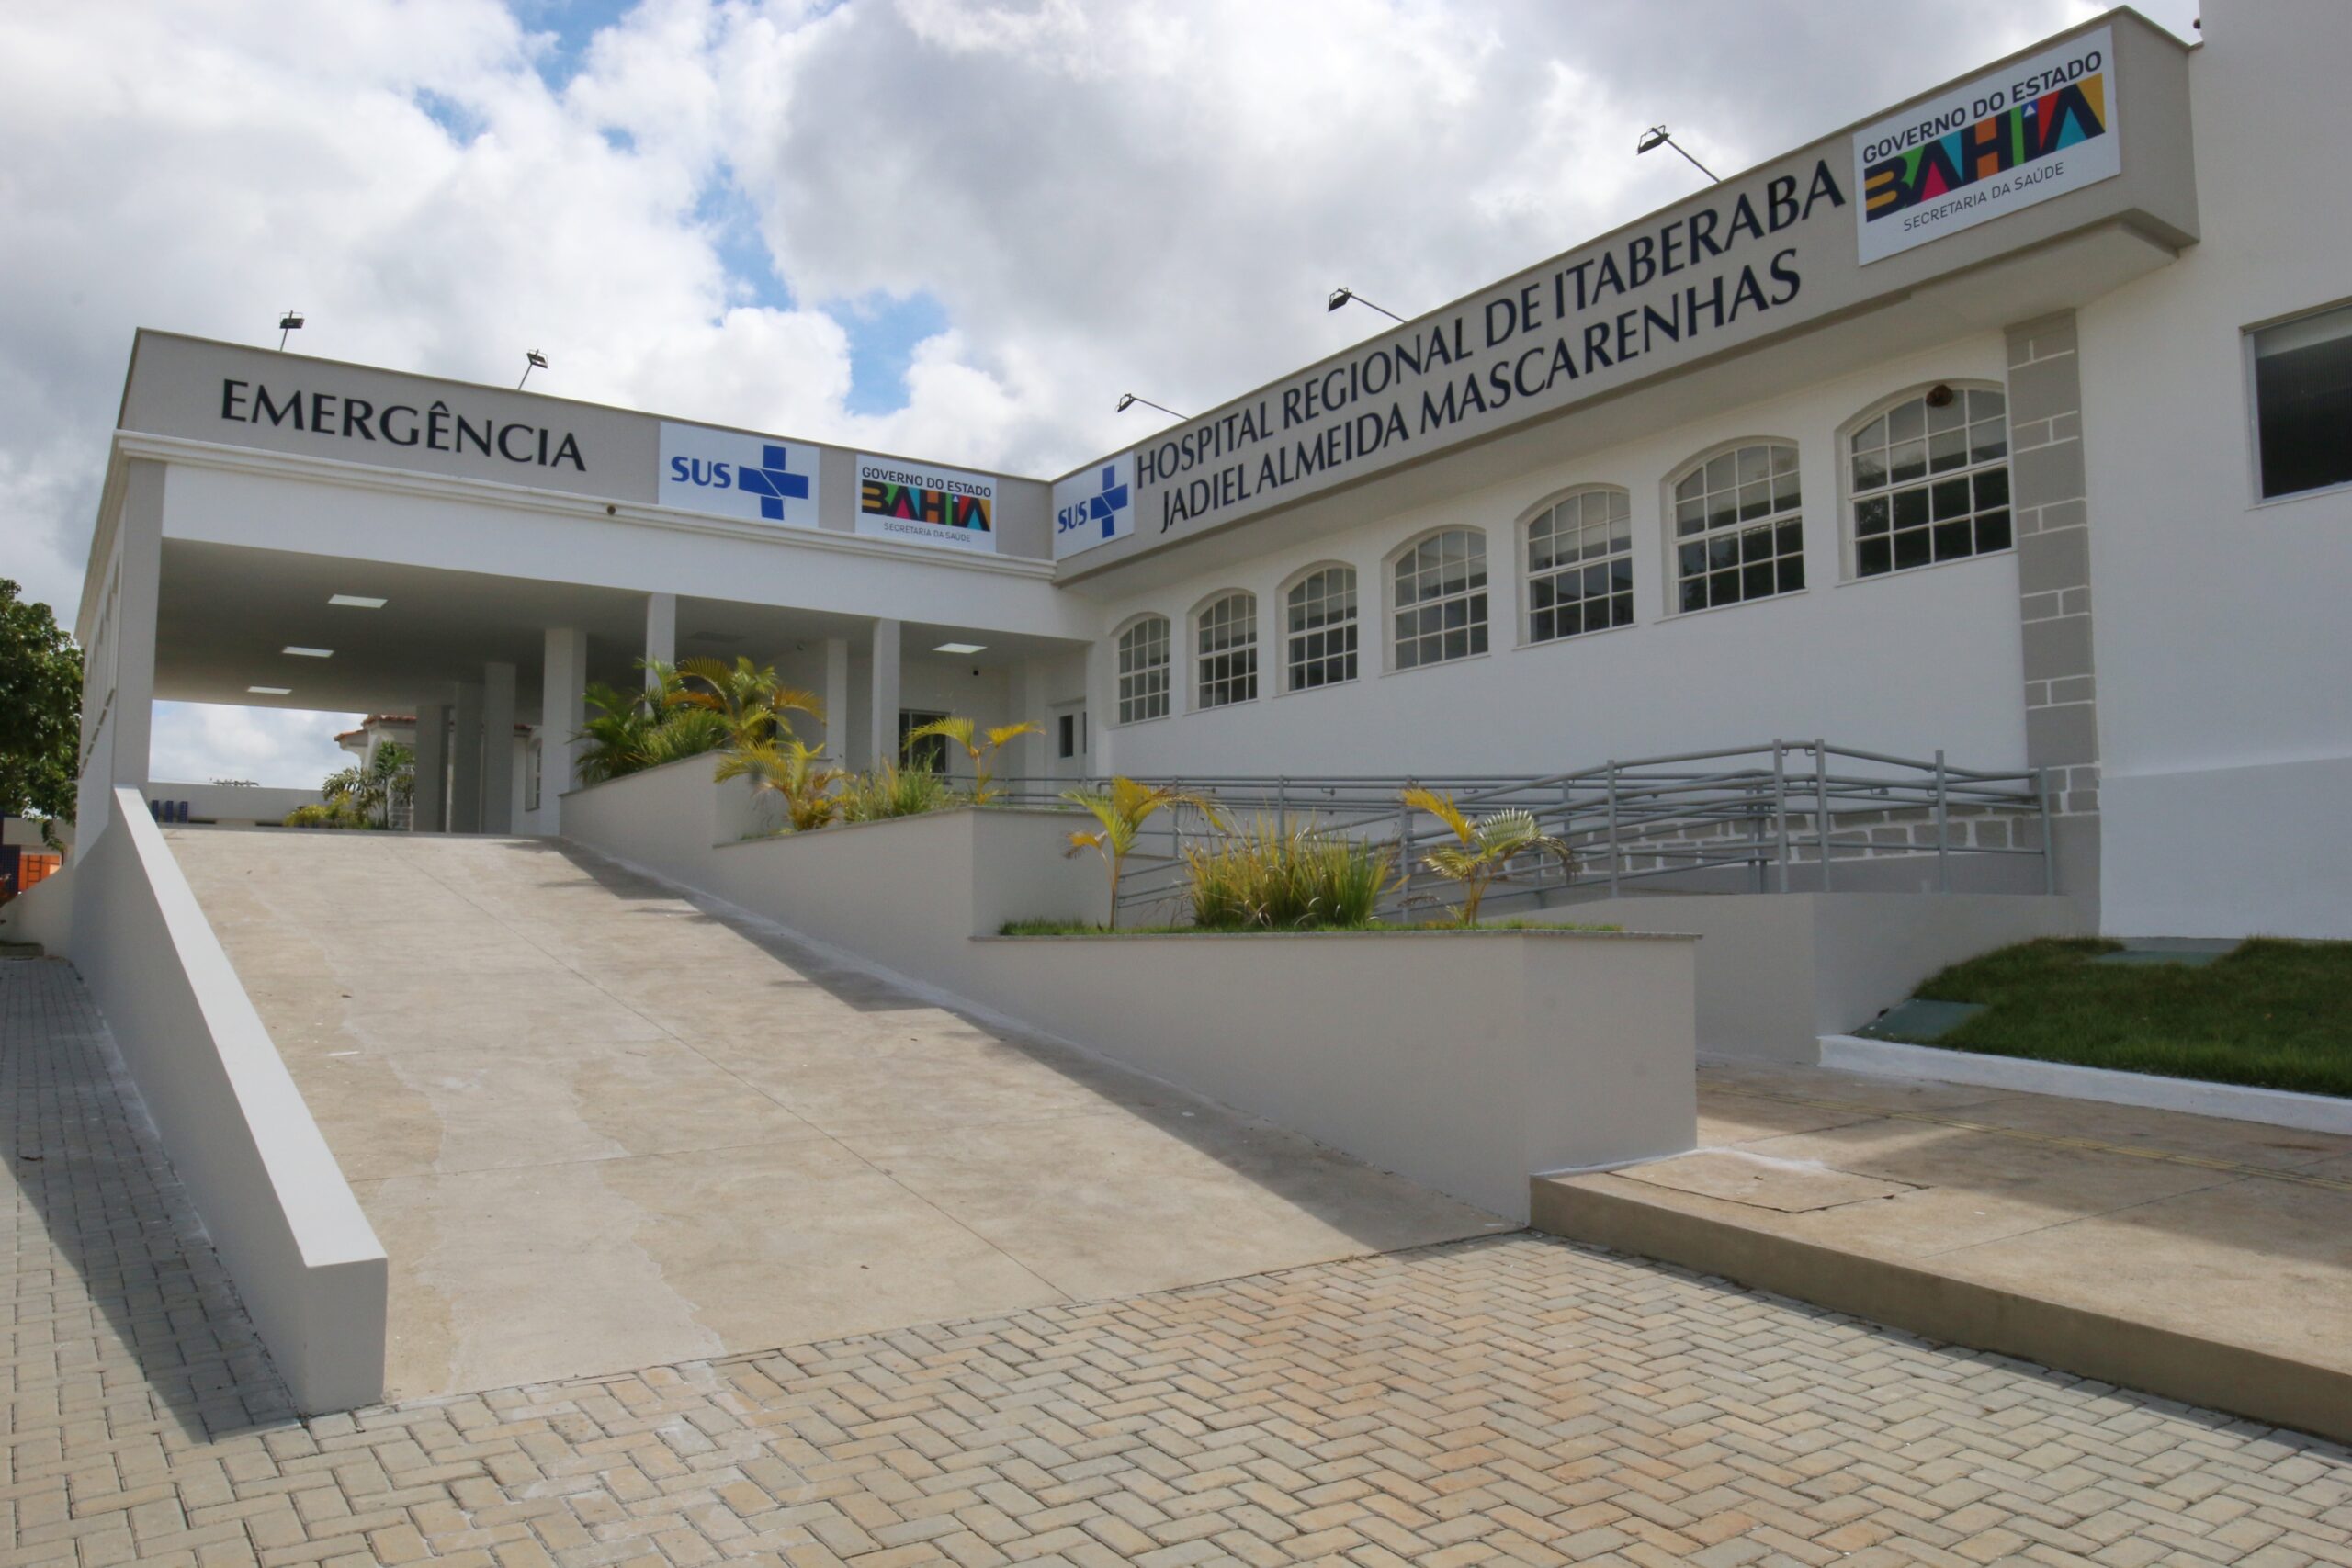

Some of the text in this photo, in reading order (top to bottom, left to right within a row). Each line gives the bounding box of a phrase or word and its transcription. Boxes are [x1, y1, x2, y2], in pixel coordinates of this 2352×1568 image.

[1863, 51, 2102, 164] GOVERNO DO ESTADO
[1864, 75, 2106, 222] BAHIA
[1904, 162, 2064, 231] SECRETARIA DA SAÚDE
[1136, 159, 1846, 489] HOSPITAL REGIONAL DE ITABERABA
[220, 378, 587, 472] EMERGÊNCIA
[1159, 248, 1801, 534] JADIEL ALMEIDA MASCARENHAS
[670, 456, 732, 489] SUS
[862, 467, 992, 498] GOVERNO DO ESTADO
[862, 479, 991, 532] BAHIA
[883, 522, 971, 543] SECRETARIA DA SAÚDE
[1057, 501, 1087, 534] SUS
